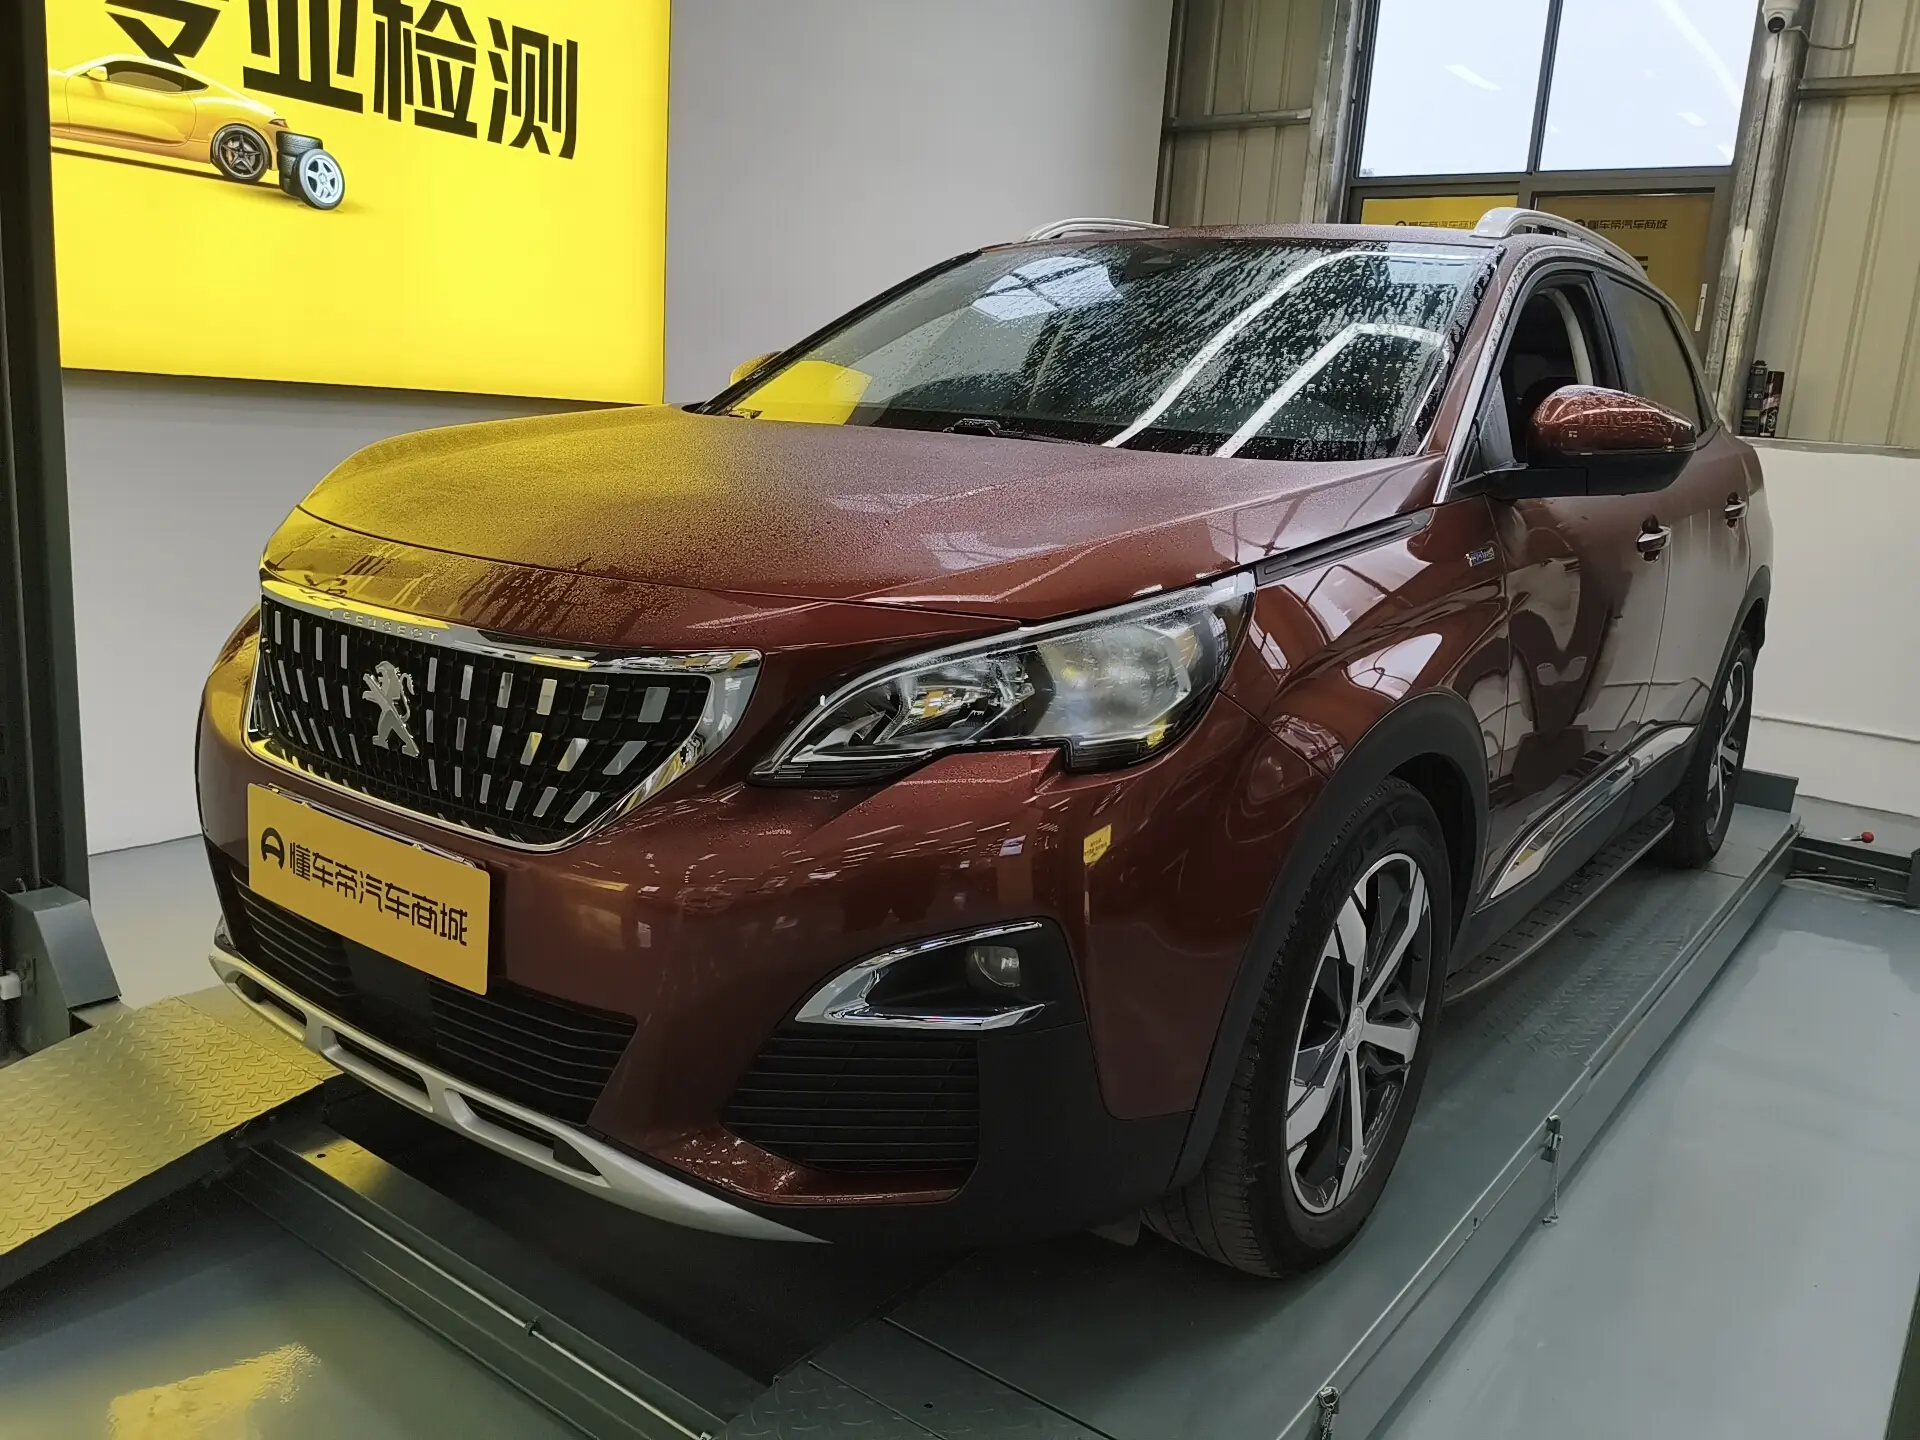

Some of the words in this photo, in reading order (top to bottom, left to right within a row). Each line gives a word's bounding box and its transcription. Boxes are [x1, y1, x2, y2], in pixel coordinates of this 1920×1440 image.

[290, 842, 468, 946] 懂车帝汽车商城
